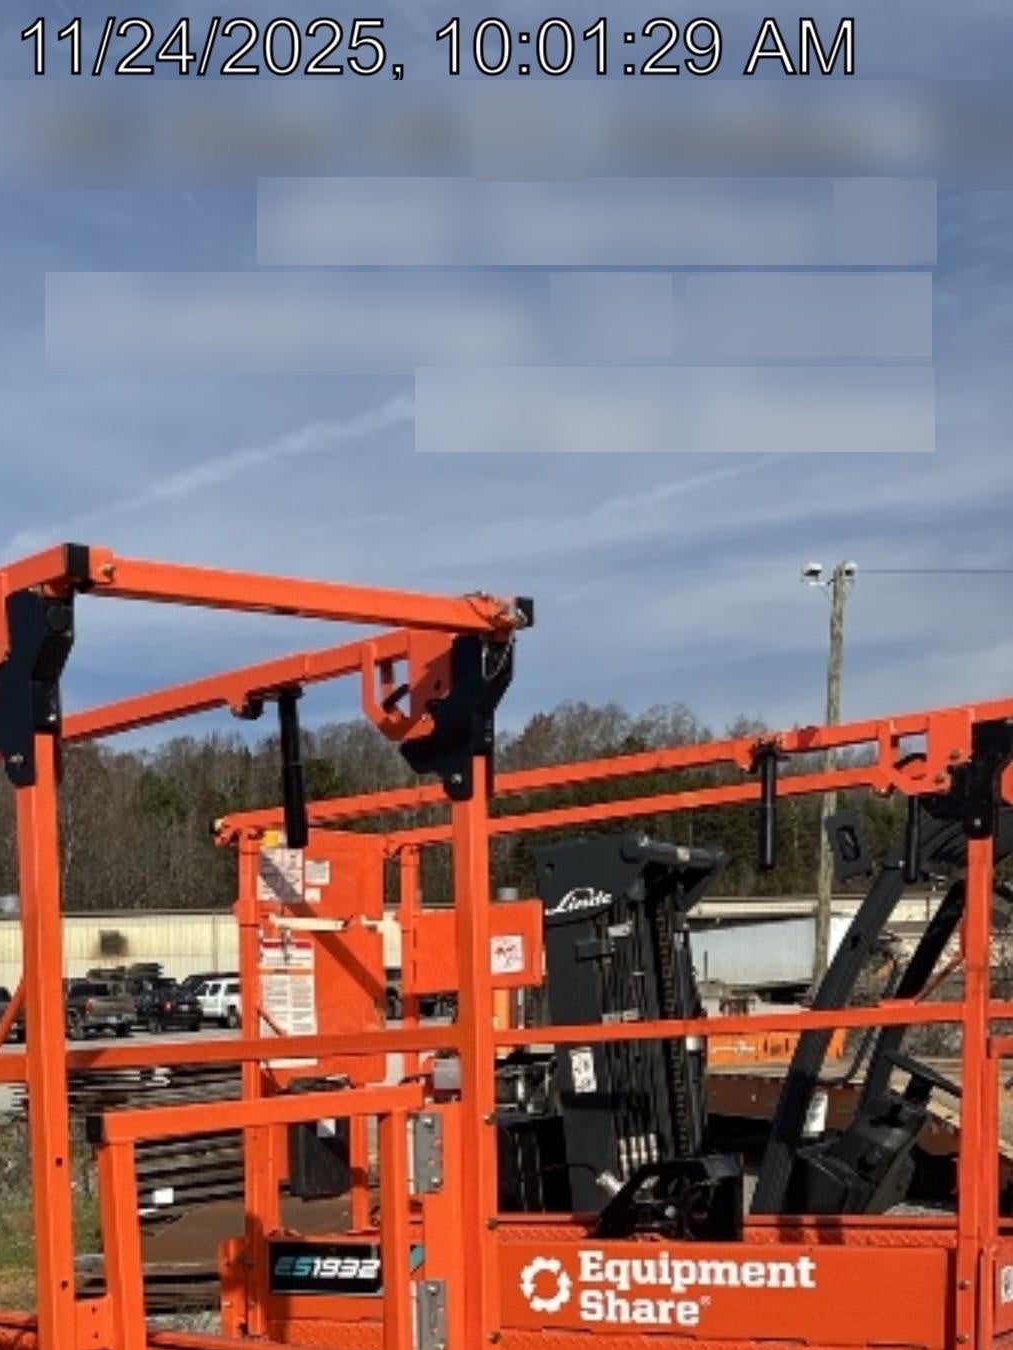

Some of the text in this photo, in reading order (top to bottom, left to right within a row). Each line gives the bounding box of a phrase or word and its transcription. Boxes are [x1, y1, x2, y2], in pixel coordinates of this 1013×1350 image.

[544, 887, 613, 916] Linde
[274, 1256, 381, 1279] ES1932
[579, 1250, 816, 1291] Equipment
